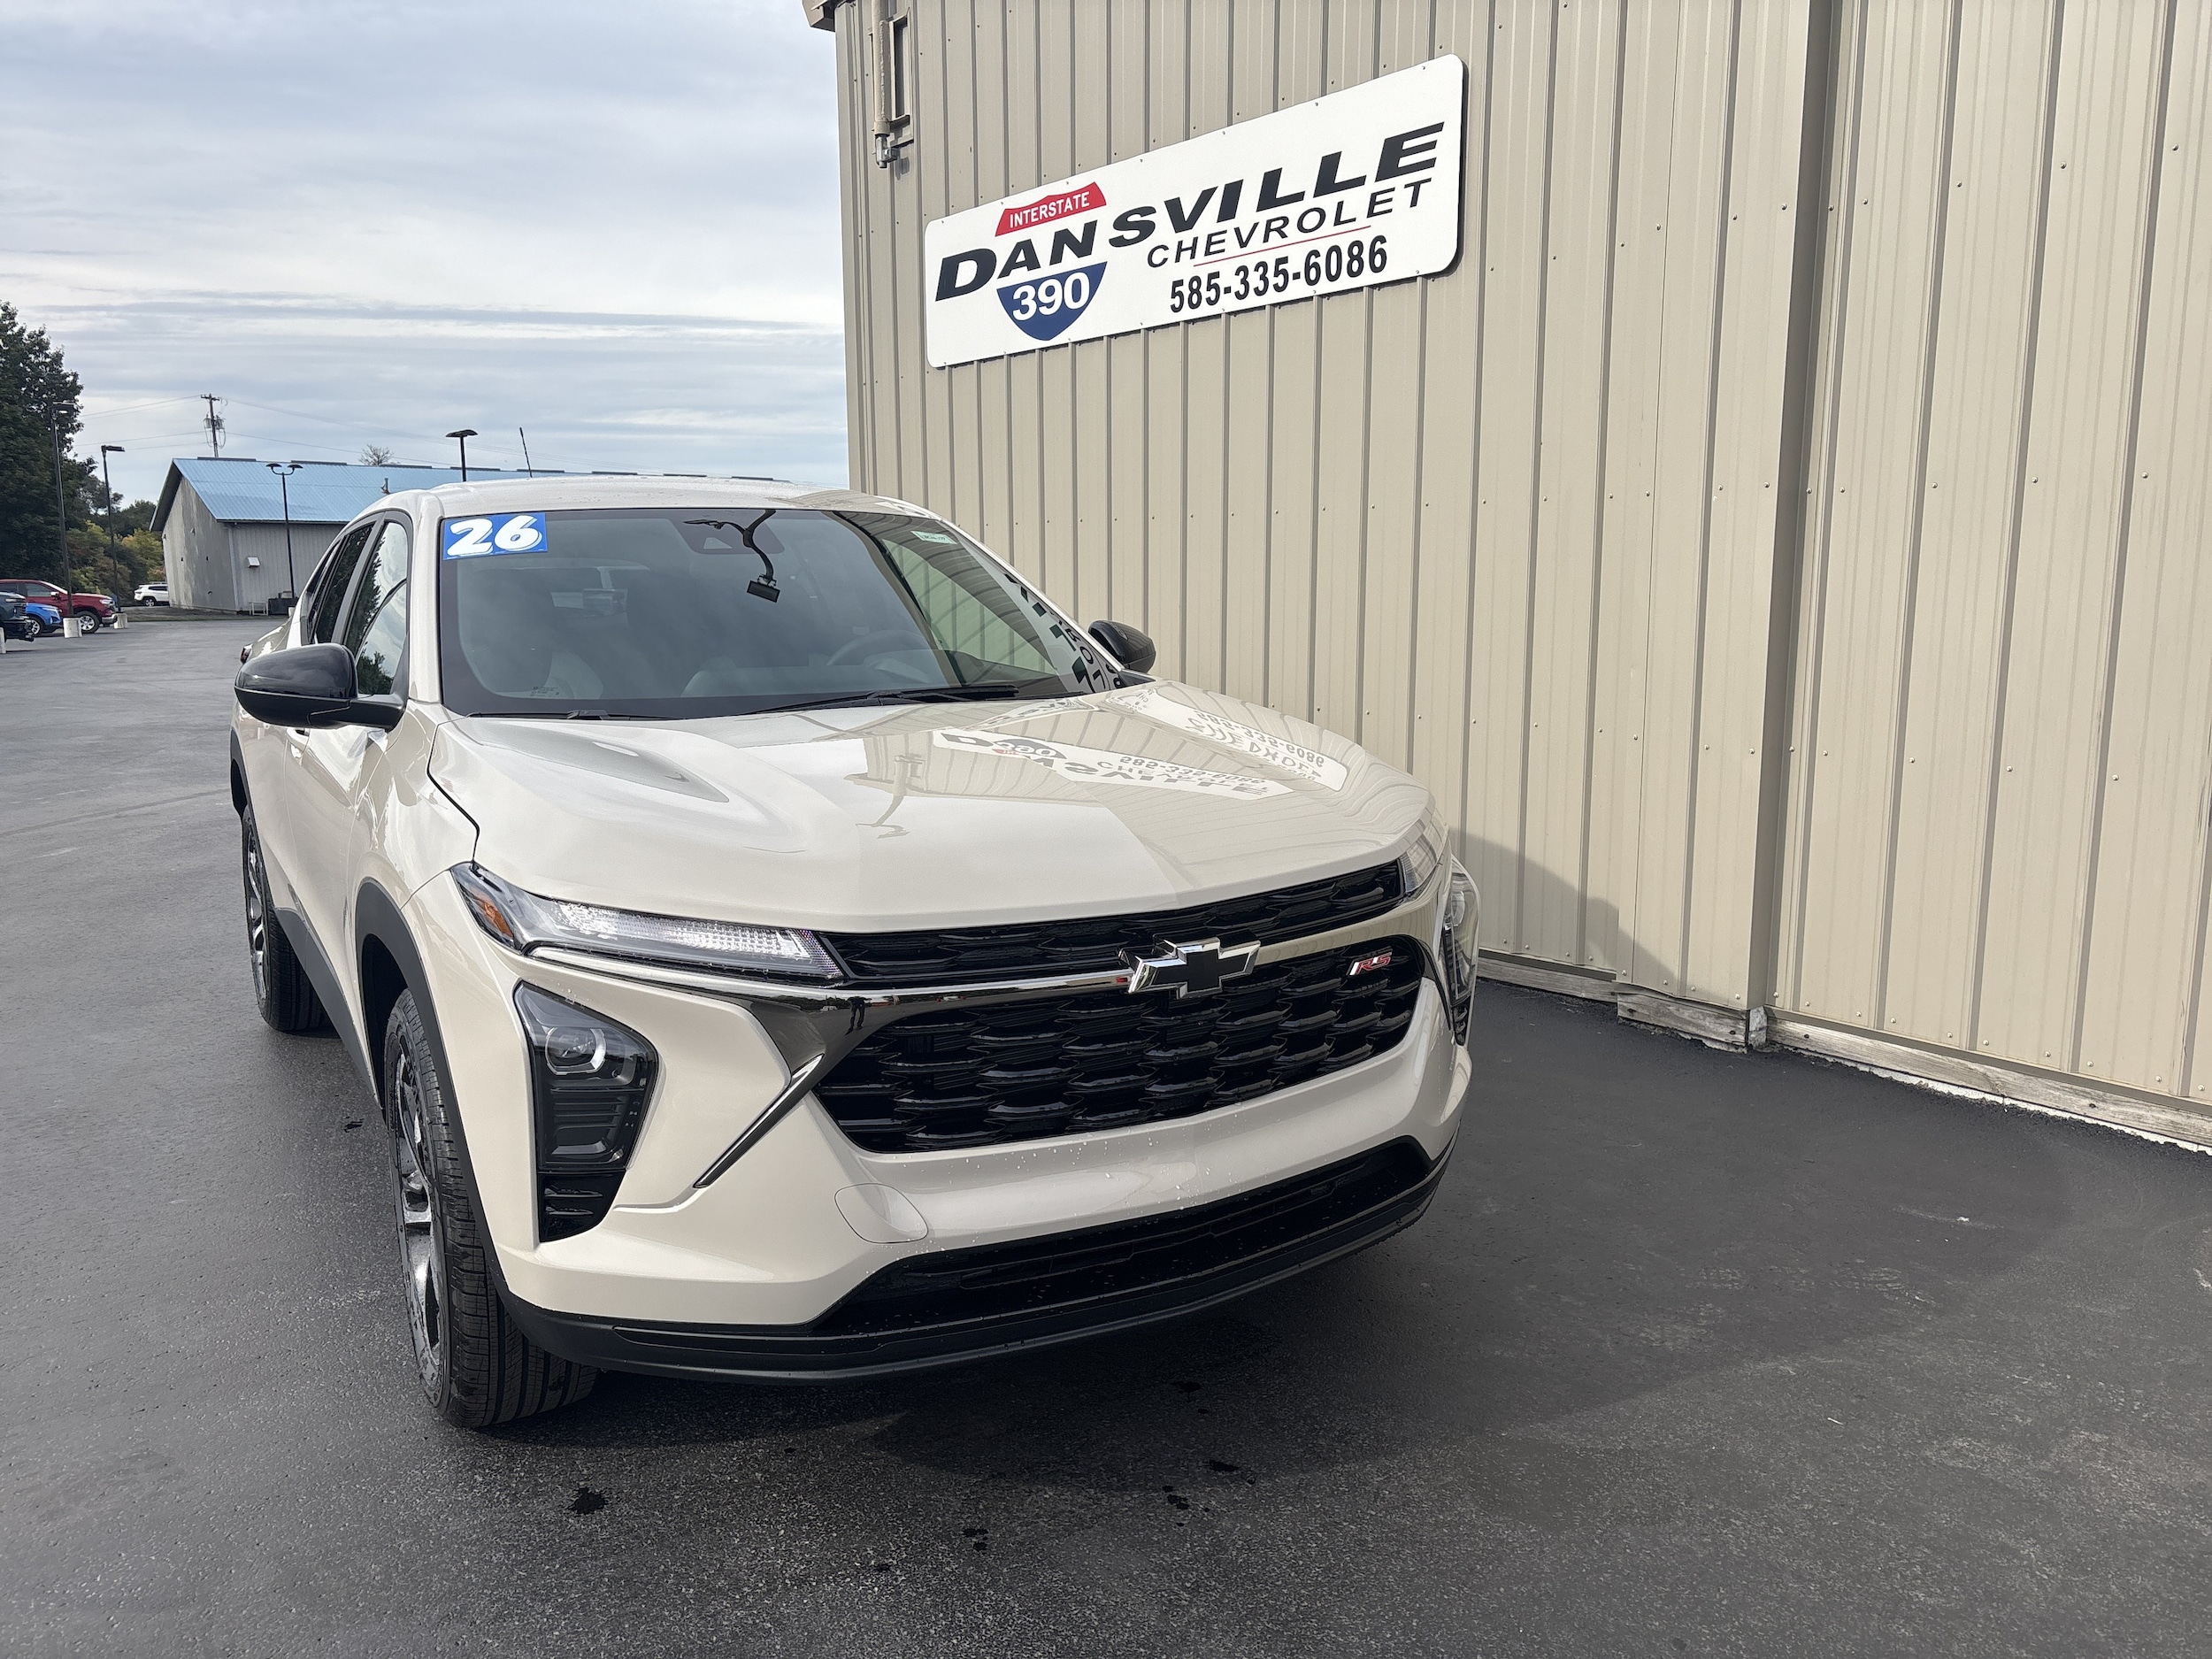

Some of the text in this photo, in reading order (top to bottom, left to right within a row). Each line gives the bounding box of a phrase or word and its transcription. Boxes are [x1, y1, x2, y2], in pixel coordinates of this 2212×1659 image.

[935, 120, 1445, 303] DANSVILLE
[1010, 190, 1090, 229] INTERSTATE
[1147, 177, 1432, 268] CHEVROLET
[1012, 271, 1090, 321] 390
[1170, 234, 1387, 313] 585-335-6086
[447, 515, 543, 557] 26
[1349, 951, 1393, 976] RS
